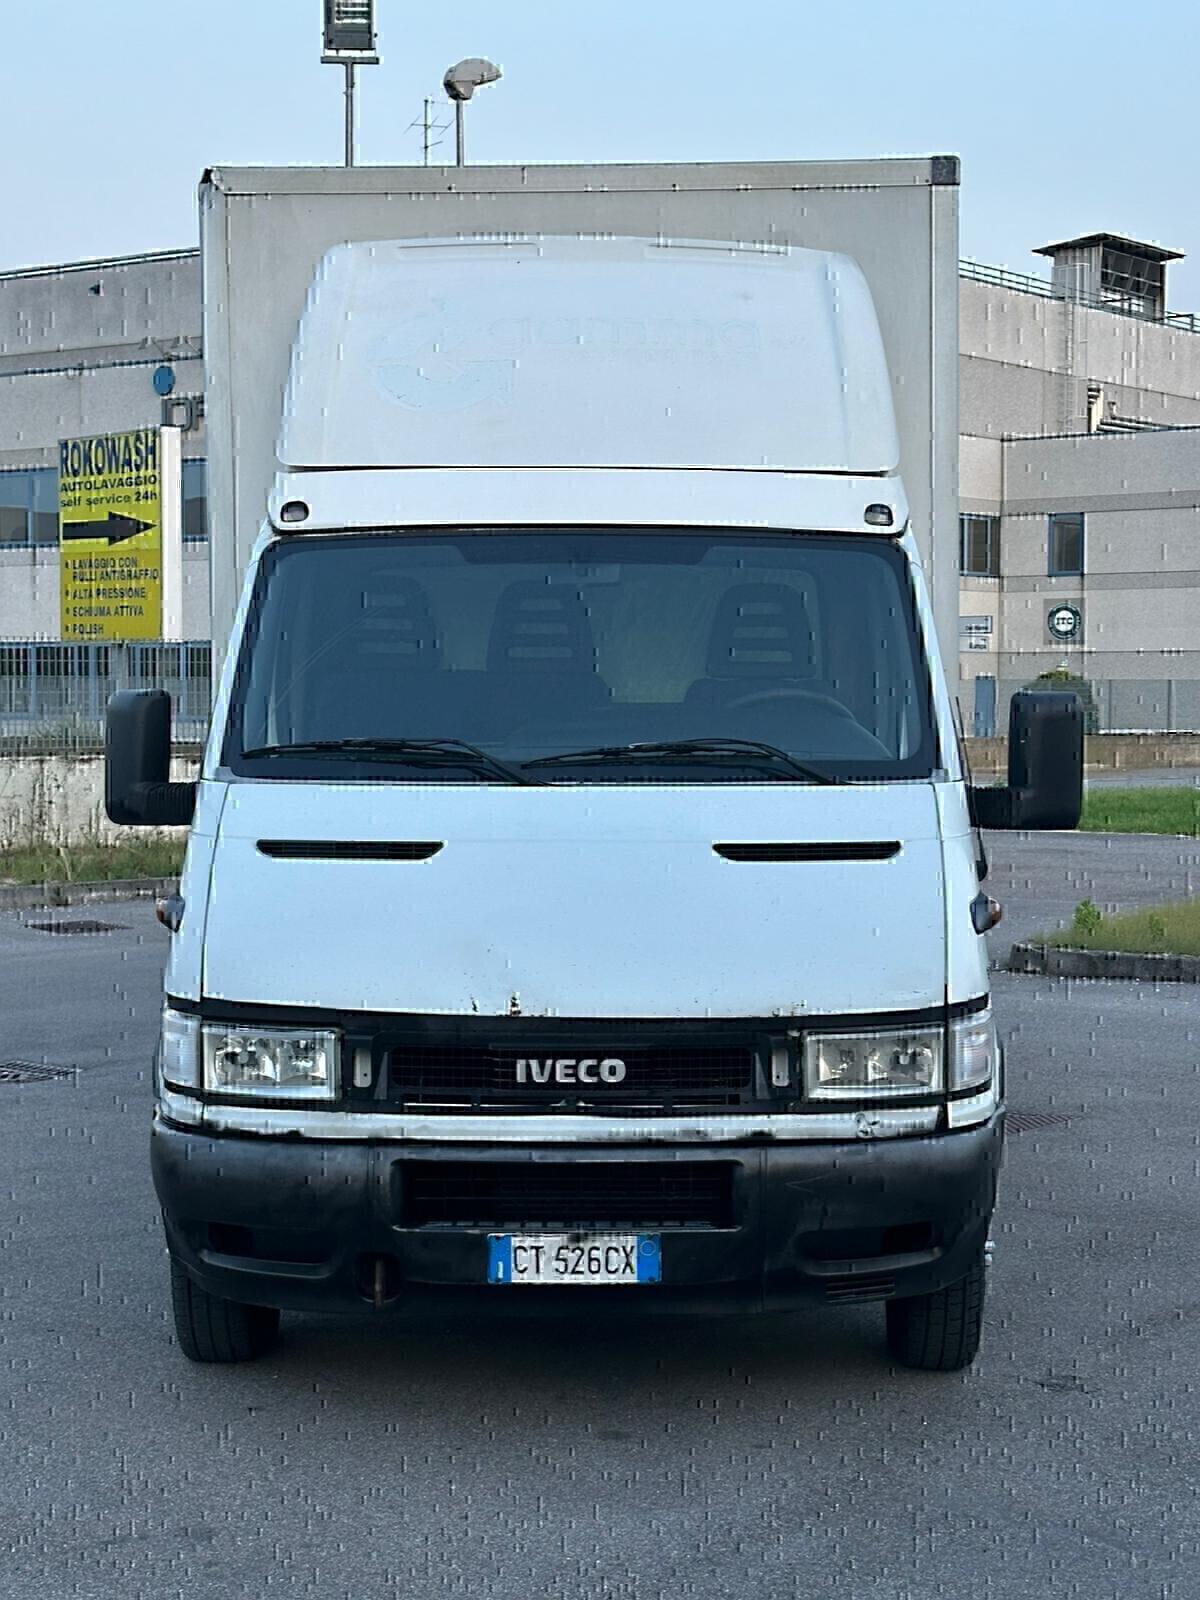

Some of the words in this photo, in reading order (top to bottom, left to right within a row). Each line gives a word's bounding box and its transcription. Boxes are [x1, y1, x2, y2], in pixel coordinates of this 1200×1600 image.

[60, 431, 158, 479] ROKOWASH
[60, 475, 157, 493] AUTOLAVAGGIO
[60, 496, 81, 507] self
[86, 494, 131, 506] service
[134, 490, 157, 502] 24h
[72, 558, 116, 569] LAVAGGIO
[118, 557, 138, 568] CON
[72, 588, 93, 600] ALTA
[96, 587, 146, 599] PRESSIONE
[114, 605, 144, 617] ATTIVA
[1056, 617, 1073, 625] ITC
[516, 1059, 626, 1083] IVECO
[513, 1245, 544, 1275] CT
[555, 1245, 635, 1275] 526CX
